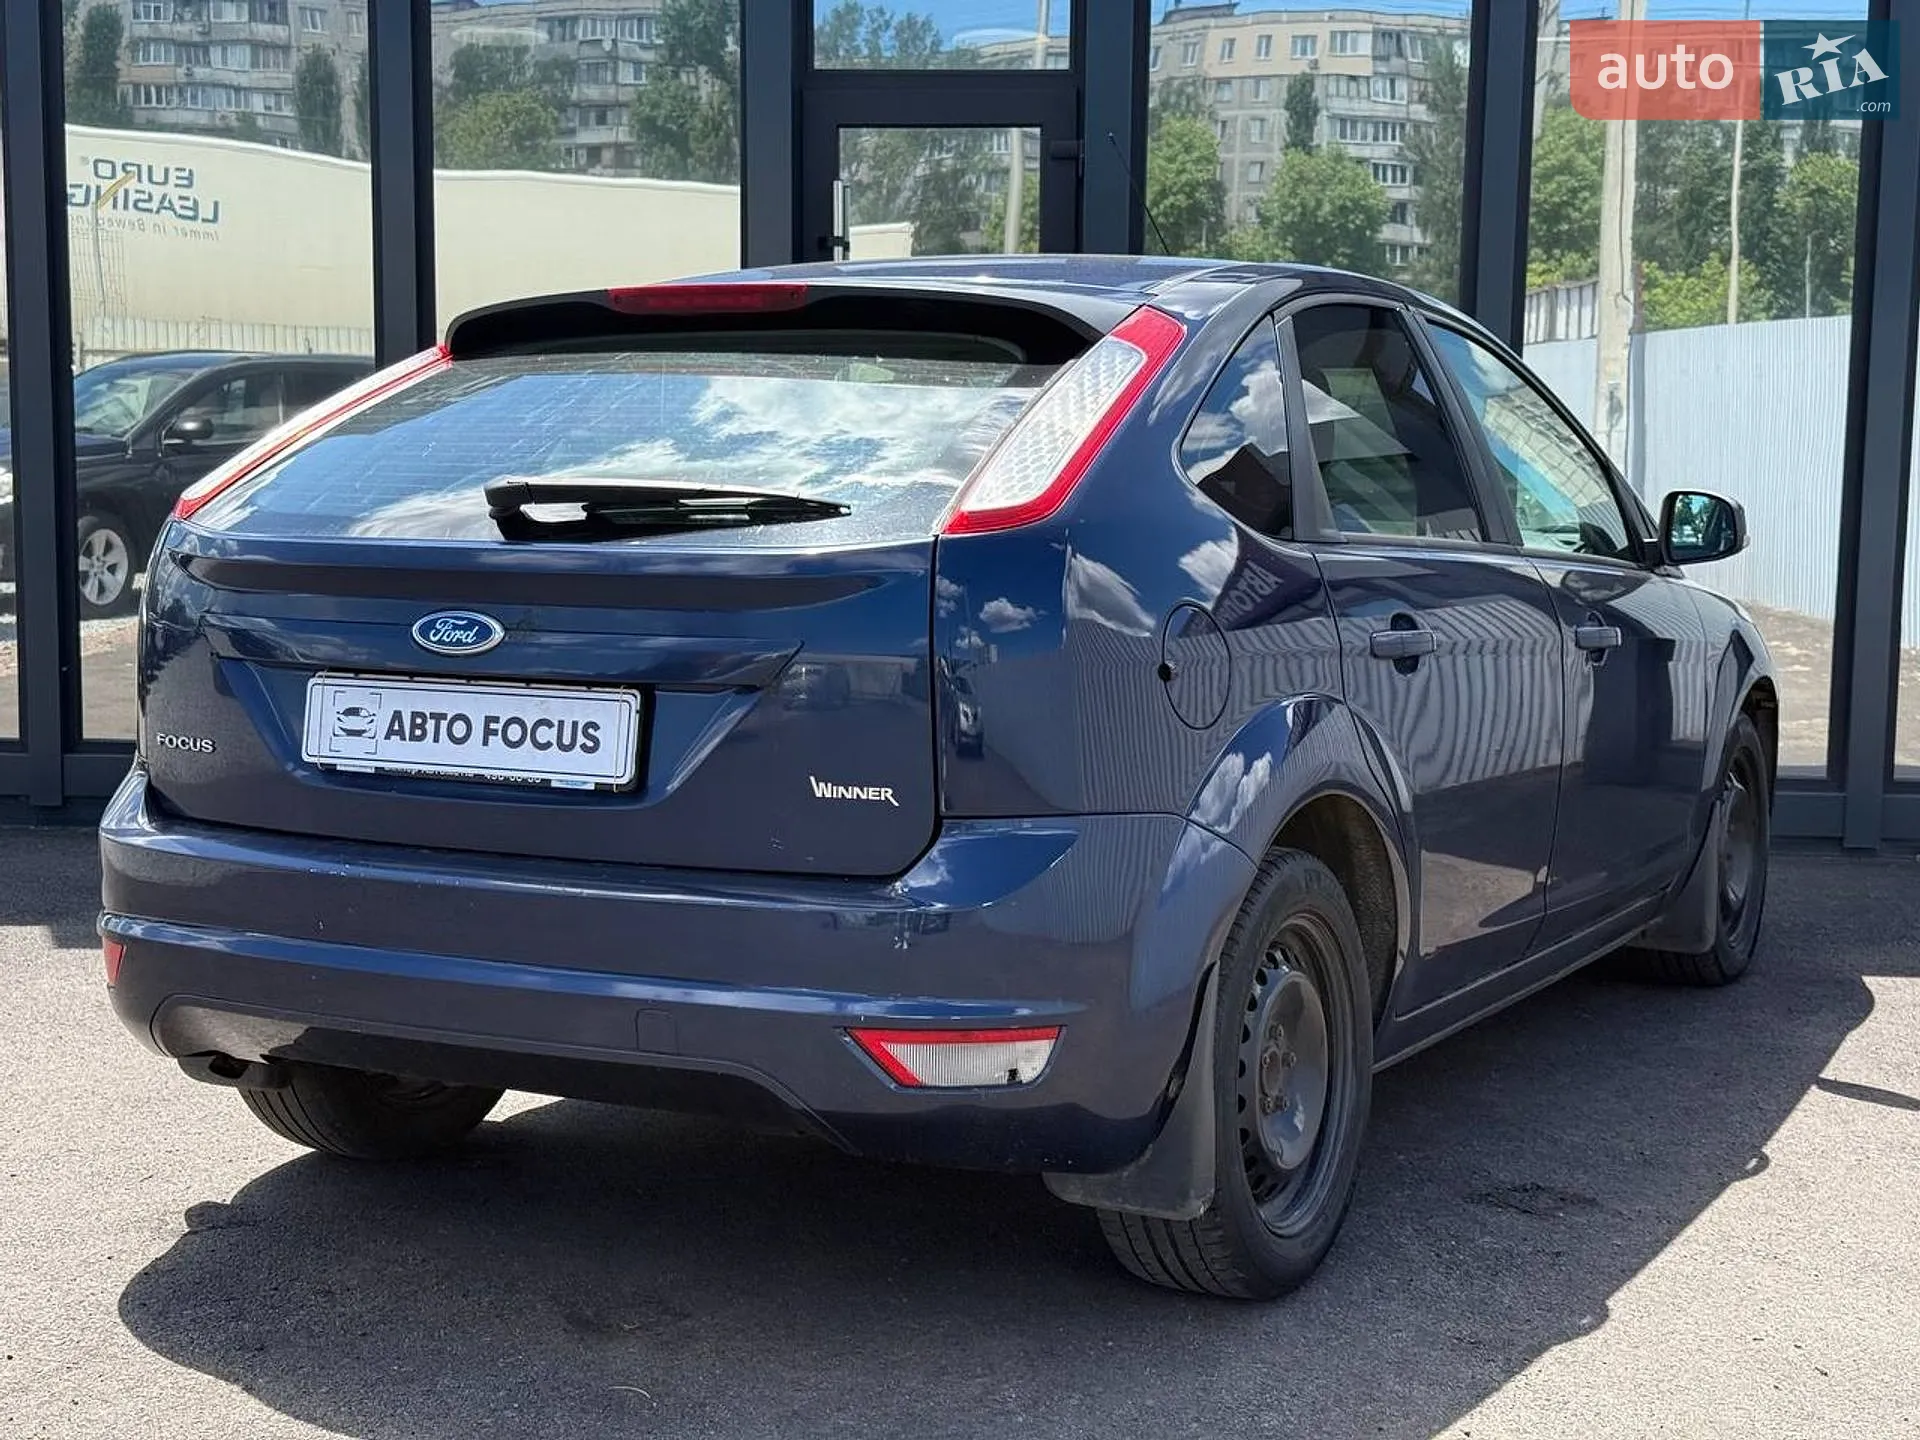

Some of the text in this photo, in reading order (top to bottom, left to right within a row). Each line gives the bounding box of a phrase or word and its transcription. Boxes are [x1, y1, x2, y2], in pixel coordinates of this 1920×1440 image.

[429, 618, 480, 644] Ford
[156, 732, 214, 753] FOCUS
[384, 709, 602, 754] АВТО FOCUS
[809, 775, 900, 807] WINNER
